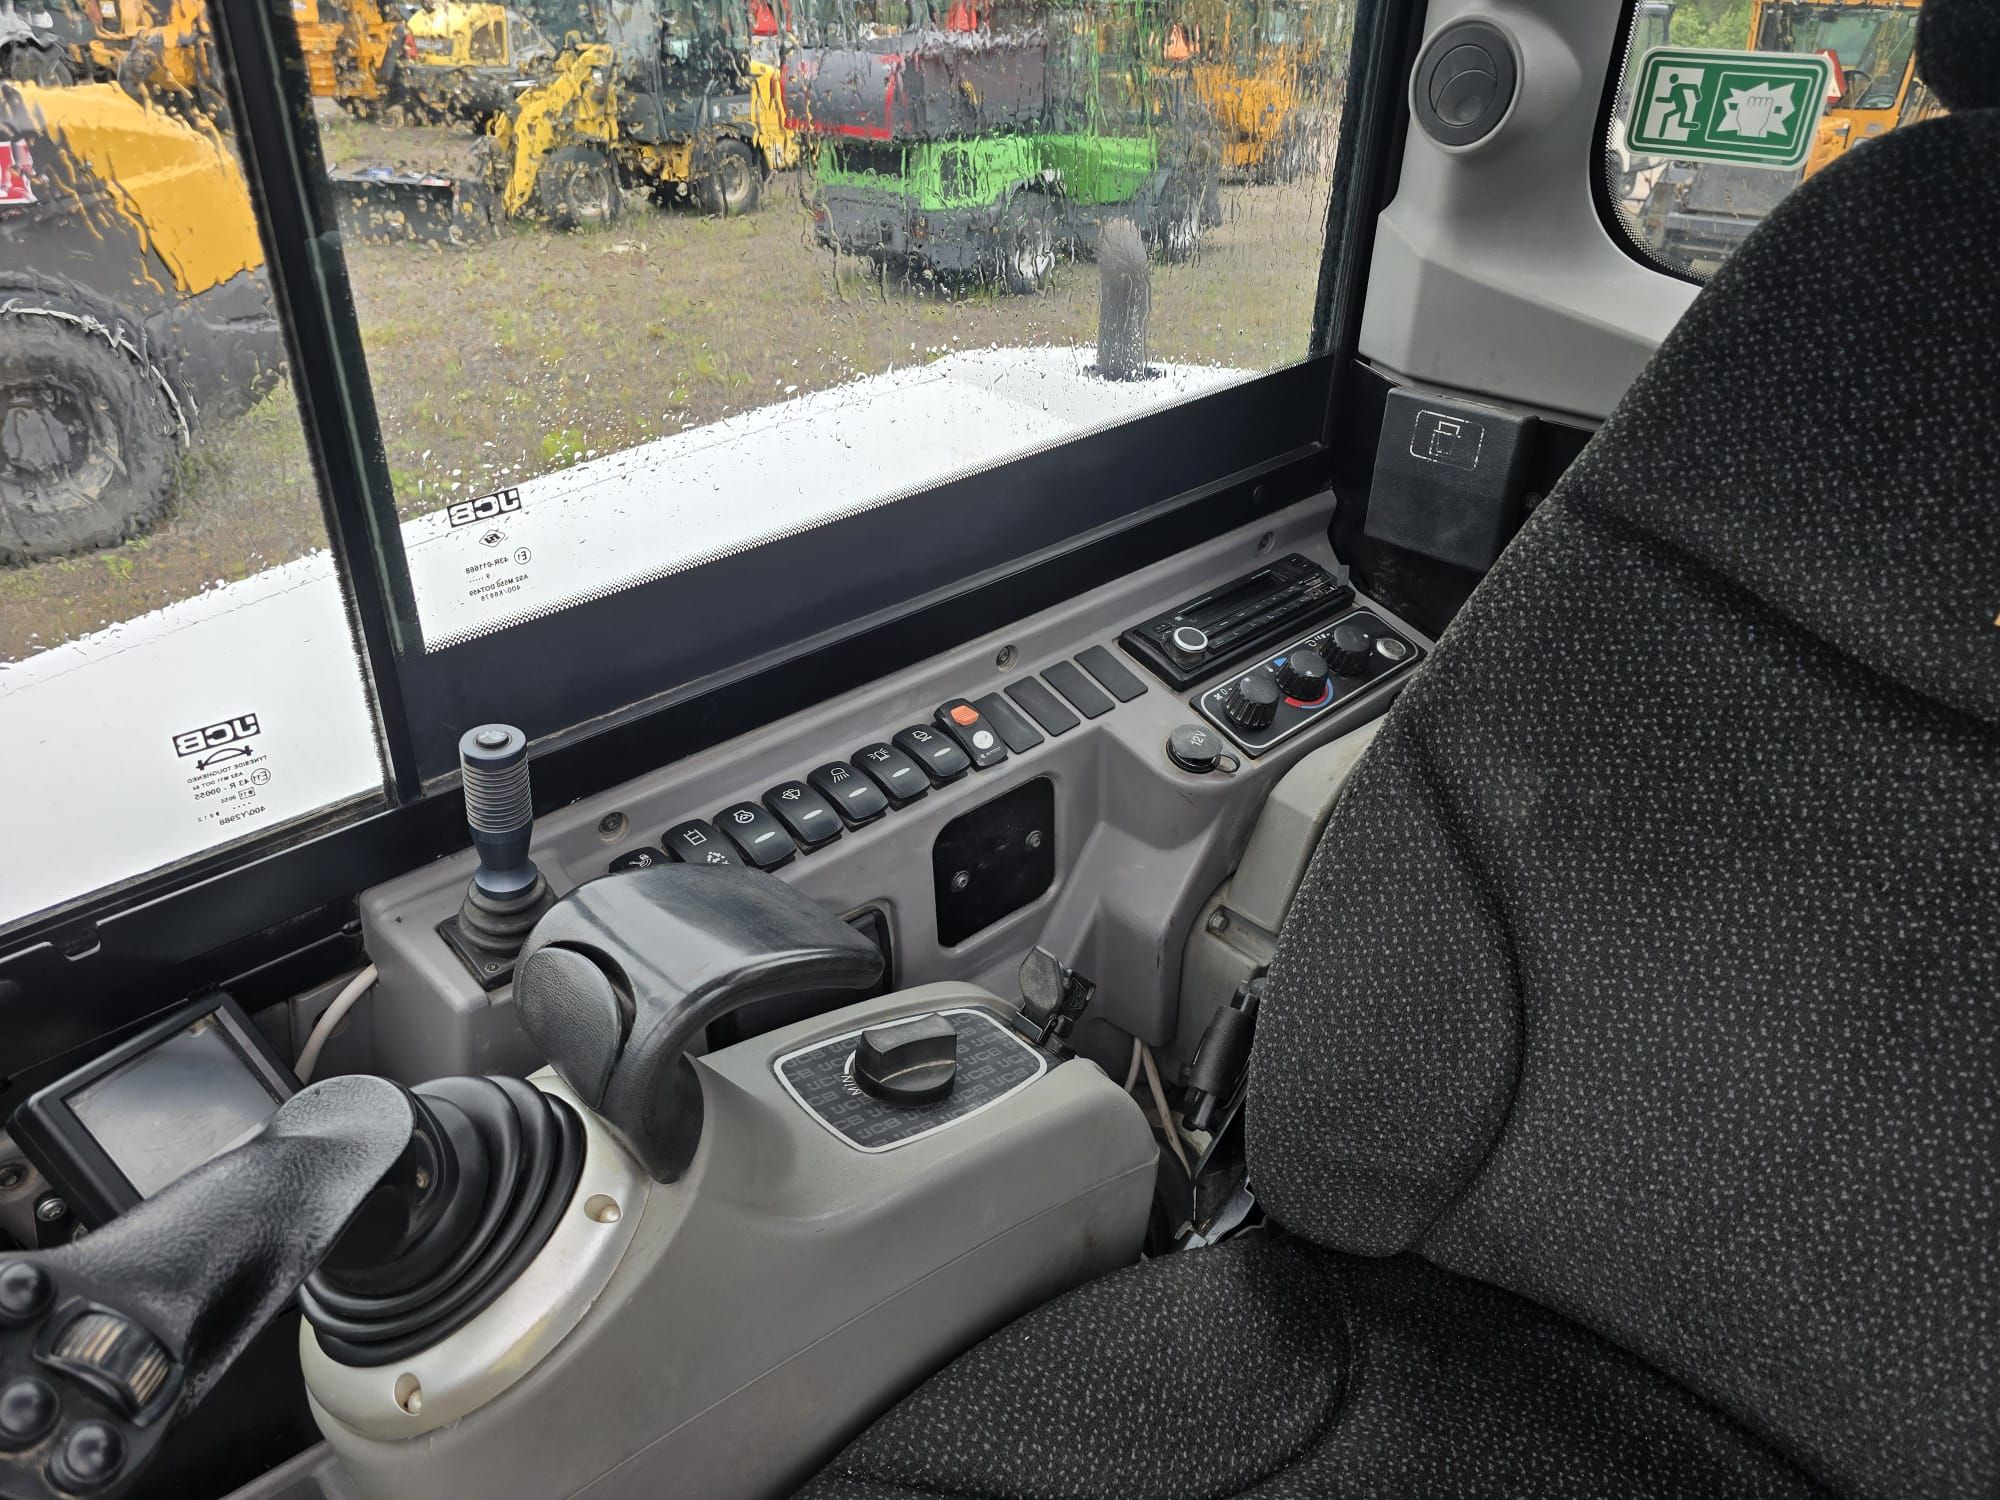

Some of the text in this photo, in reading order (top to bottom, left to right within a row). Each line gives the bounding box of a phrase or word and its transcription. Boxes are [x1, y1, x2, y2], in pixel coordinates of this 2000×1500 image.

[1190, 730, 1206, 746] 12V
[963, 1047, 1002, 1065] JCB
[957, 1064, 997, 1084] JCB
[990, 1068, 1029, 1086] JCB
[840, 1074, 862, 1096] MIN
[856, 1117, 902, 1139] JCB
